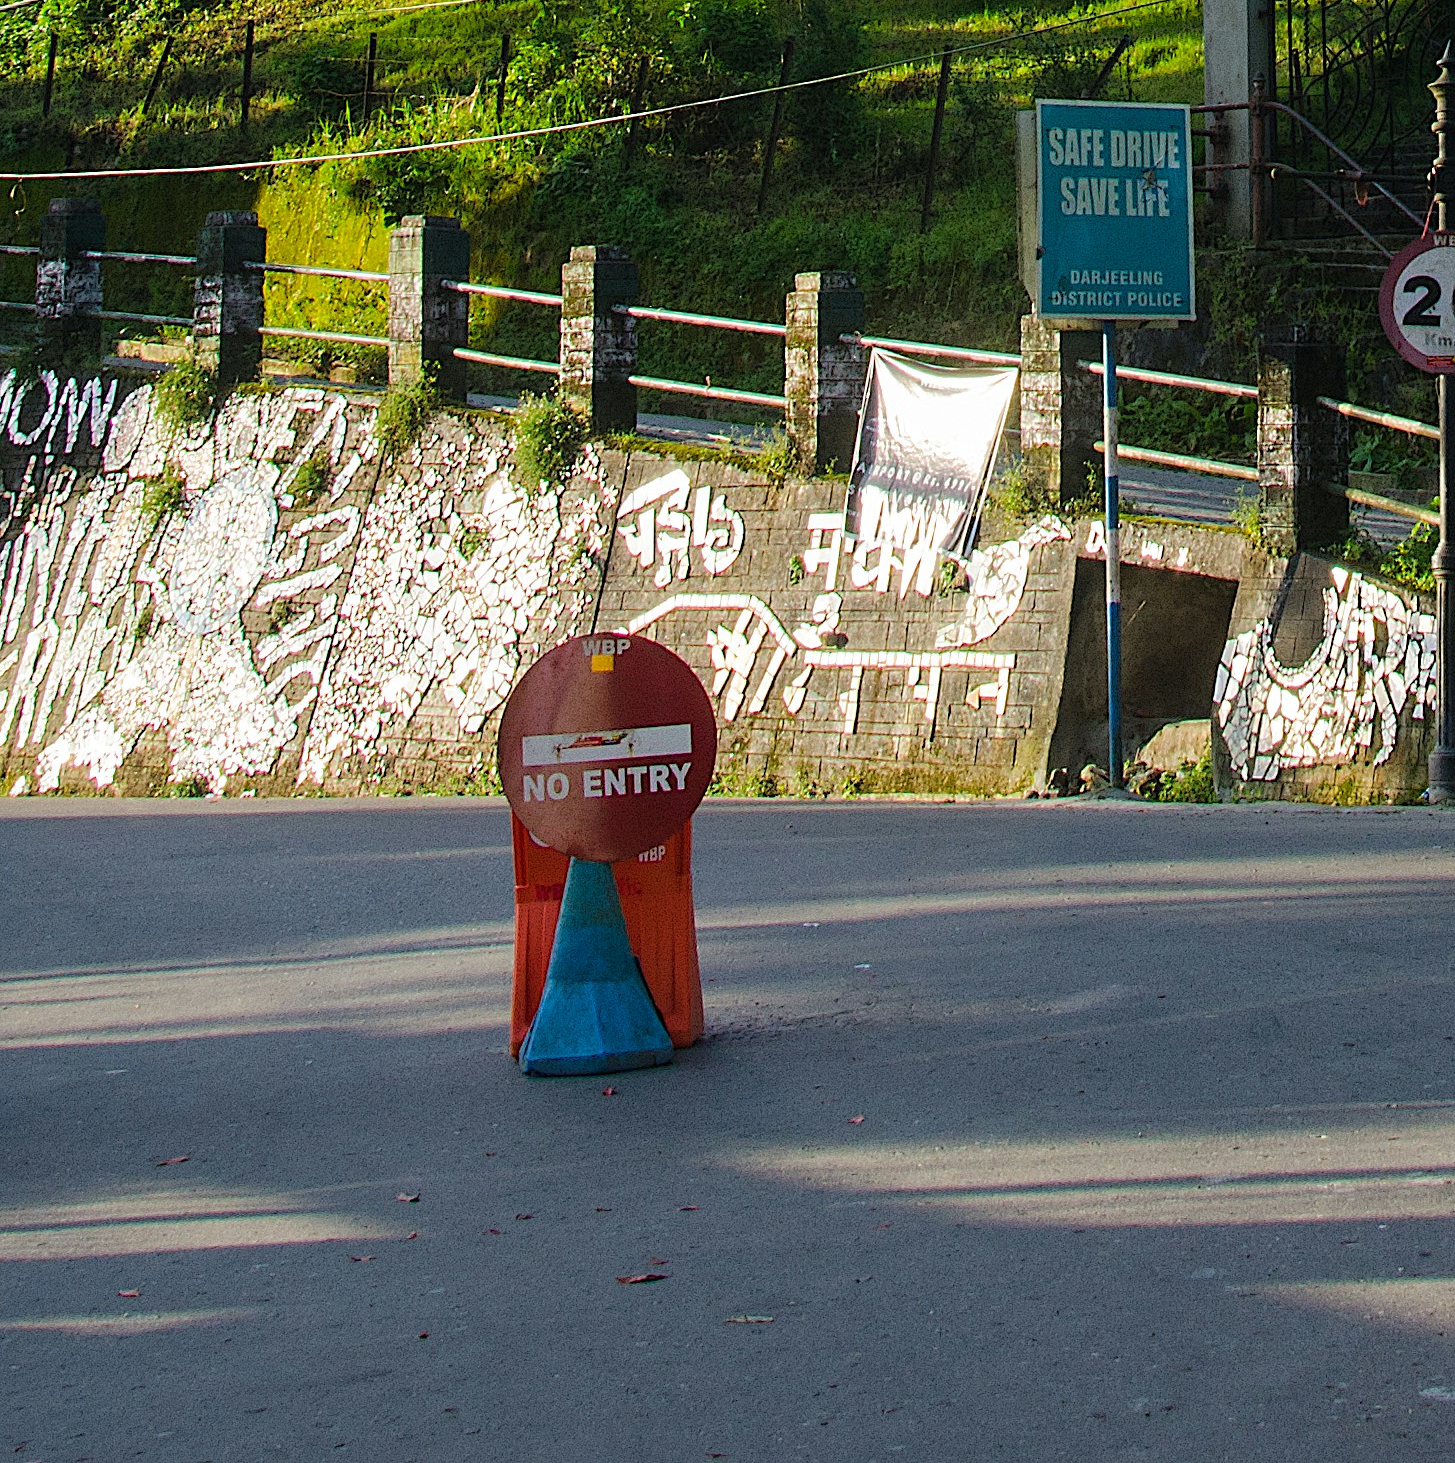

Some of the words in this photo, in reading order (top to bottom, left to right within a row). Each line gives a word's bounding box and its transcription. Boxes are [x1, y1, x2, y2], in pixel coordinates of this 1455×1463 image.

[1049, 127, 1104, 167] SAFE
[1110, 129, 1180, 169] DRIVE
[1060, 177, 1119, 216] SAVE
[1125, 178, 1170, 217] LIFE
[1070, 269, 1163, 286] DARJEELING
[1051, 290, 1127, 307] DISTRICT
[1127, 291, 1183, 308] POLICE
[581, 638, 631, 657] WBP
[523, 772, 570, 803] NO
[584, 762, 692, 798] ENTRY
